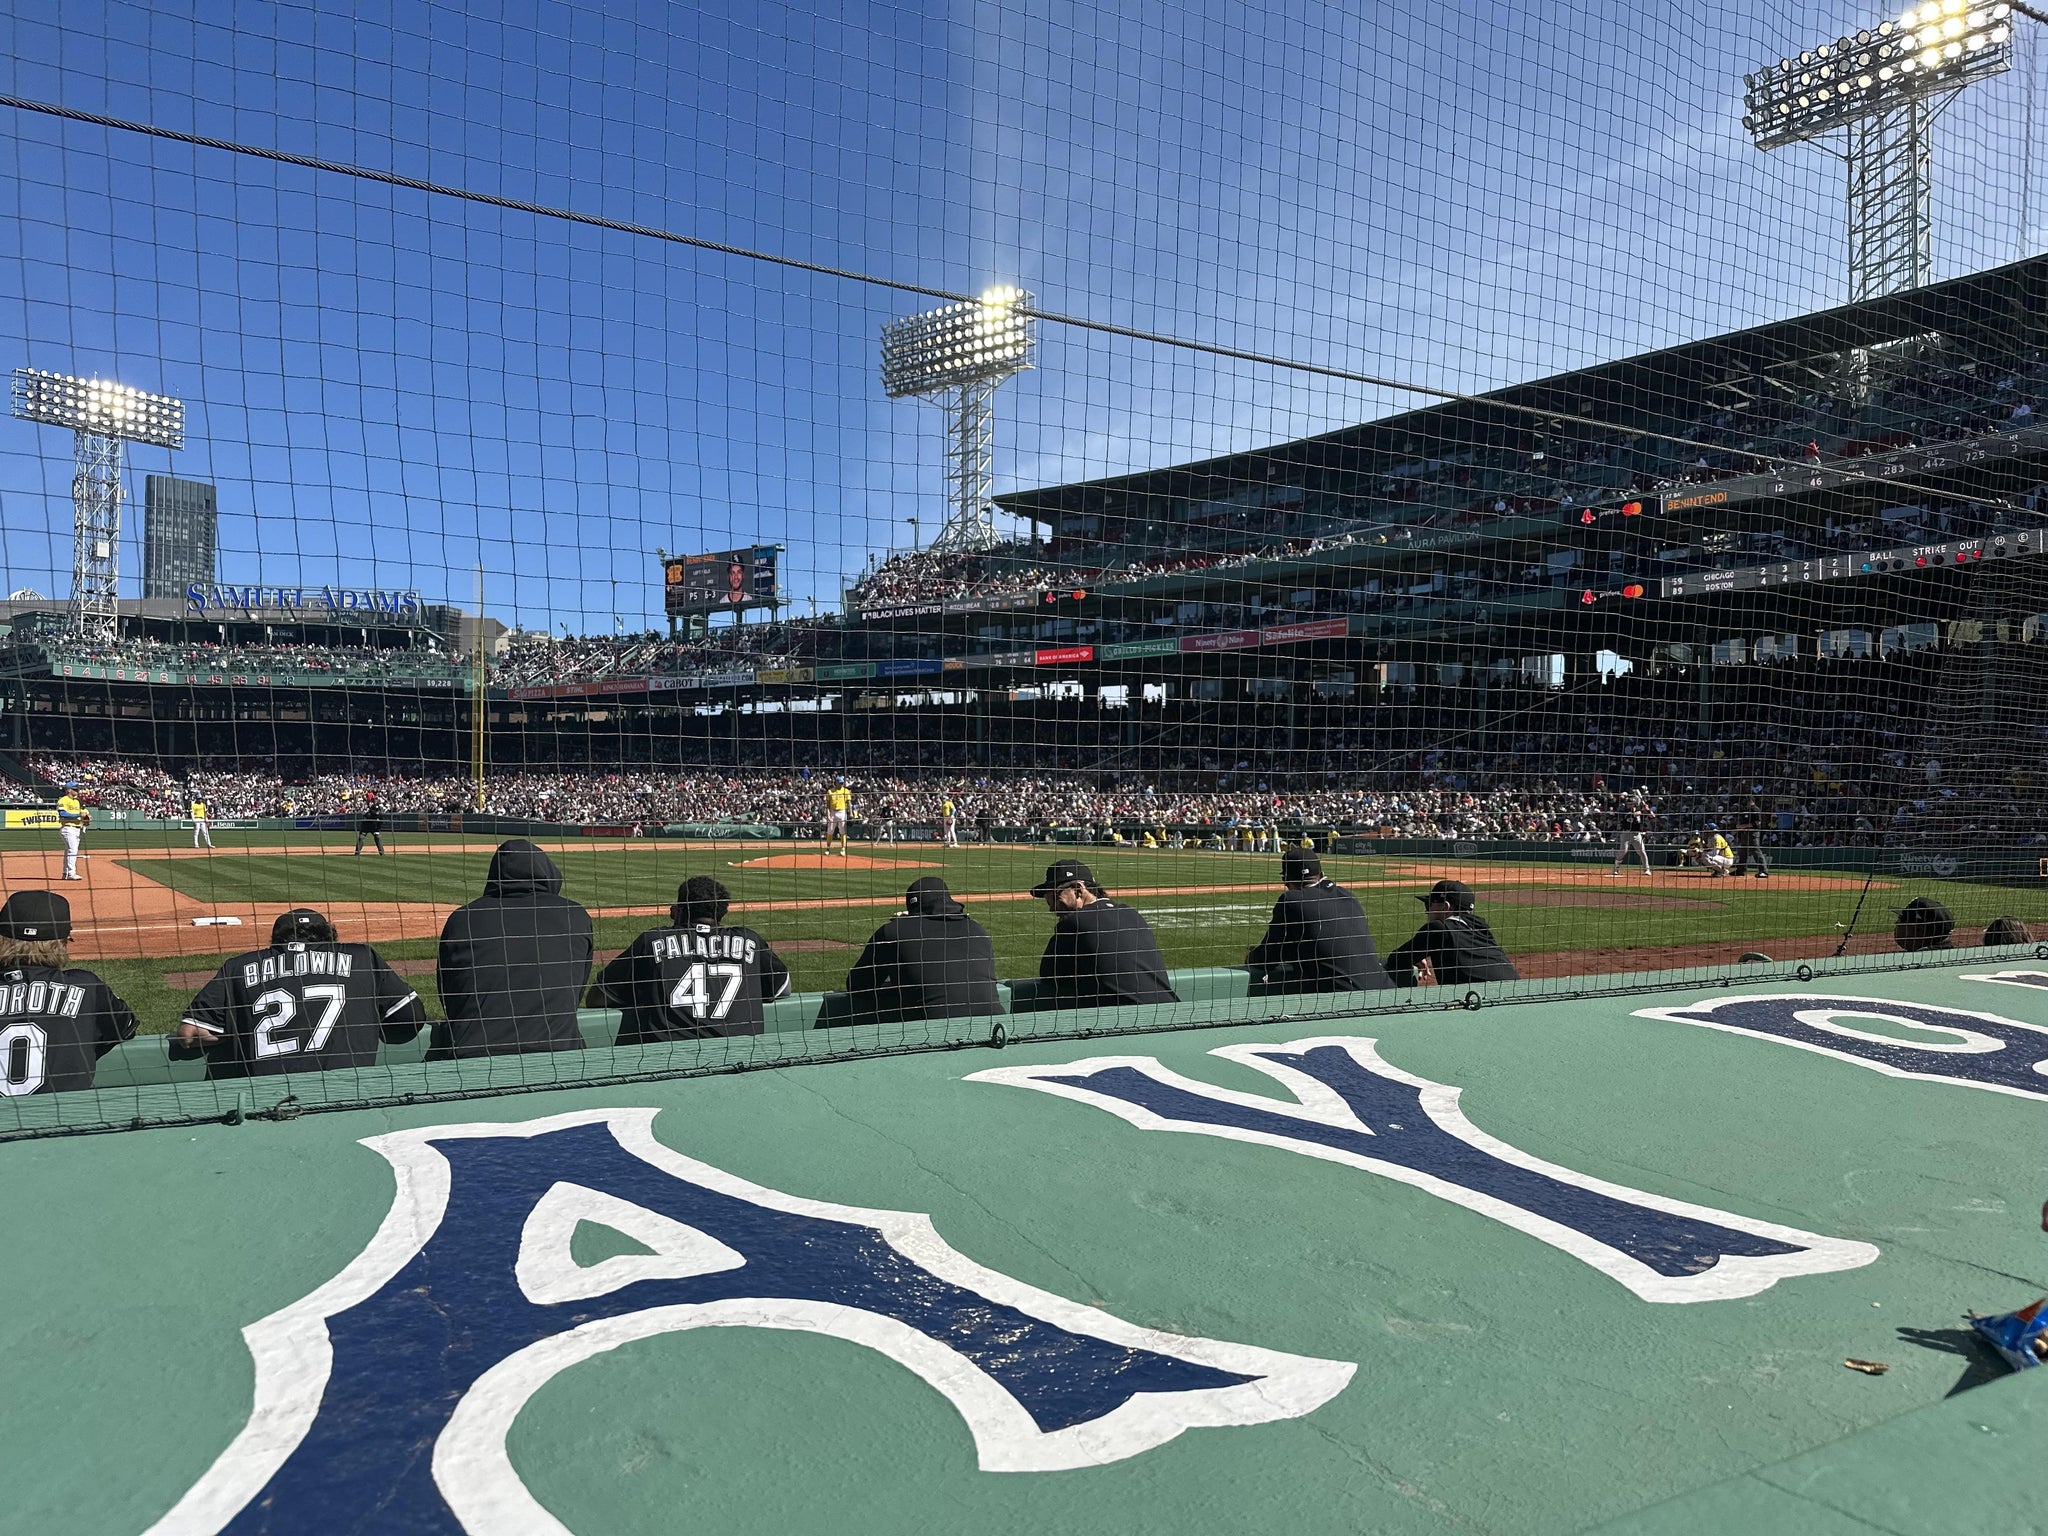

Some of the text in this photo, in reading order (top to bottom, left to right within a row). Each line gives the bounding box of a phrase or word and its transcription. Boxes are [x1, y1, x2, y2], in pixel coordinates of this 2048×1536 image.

[1775, 483, 1784, 493] 12
[1810, 477, 1822, 487] 46
[1880, 464, 1905, 476] .283
[1921, 457, 1945, 469] .442
[1961, 450, 1985, 463] .725
[2011, 444, 2018, 453] 3
[1667, 491, 1727, 511] BENINTENDI
[1438, 531, 1480, 545] PAVILION
[1869, 551, 1895, 562] BALL
[1912, 545, 1947, 556] STRIKE
[1959, 540, 1979, 550] OUT
[1703, 571, 1735, 581] CHICAGO
[1760, 567, 1766, 575] 2
[1782, 565, 1788, 573] 3
[1803, 562, 1809, 570] 2
[1832, 558, 1838, 566] 2
[1705, 582, 1734, 591] BOSTON
[1760, 577, 1767, 585] 4
[1782, 574, 1788, 582] 4
[1803, 572, 1809, 580] 0
[1832, 569, 1838, 577] 6
[187, 582, 418, 616] SAMUEL ADAMS
[872, 605, 941, 619] BLACK LIVES MATTER
[1265, 628, 1304, 640] Safelite
[1195, 636, 1245, 648] Ninety Nine
[82, 667, 91, 678] 4
[135, 671, 150, 682] 27
[160, 672, 168, 683] 6
[207, 674, 223, 685] 45
[282, 675, 295, 686] 42
[426, 679, 451, 687] $9,228
[566, 686, 584, 694] STIHL
[528, 689, 545, 697] PIZZA
[21, 814, 57, 826] TWISTED
[110, 811, 127, 819] 380
[1900, 854, 1932, 863] Ninety
[1900, 863, 1931, 872] Nine
[652, 934, 757, 964] PALACIOS
[243, 950, 352, 988] BALDWIN
[670, 962, 743, 1019] 47
[252, 984, 346, 1059] 27
